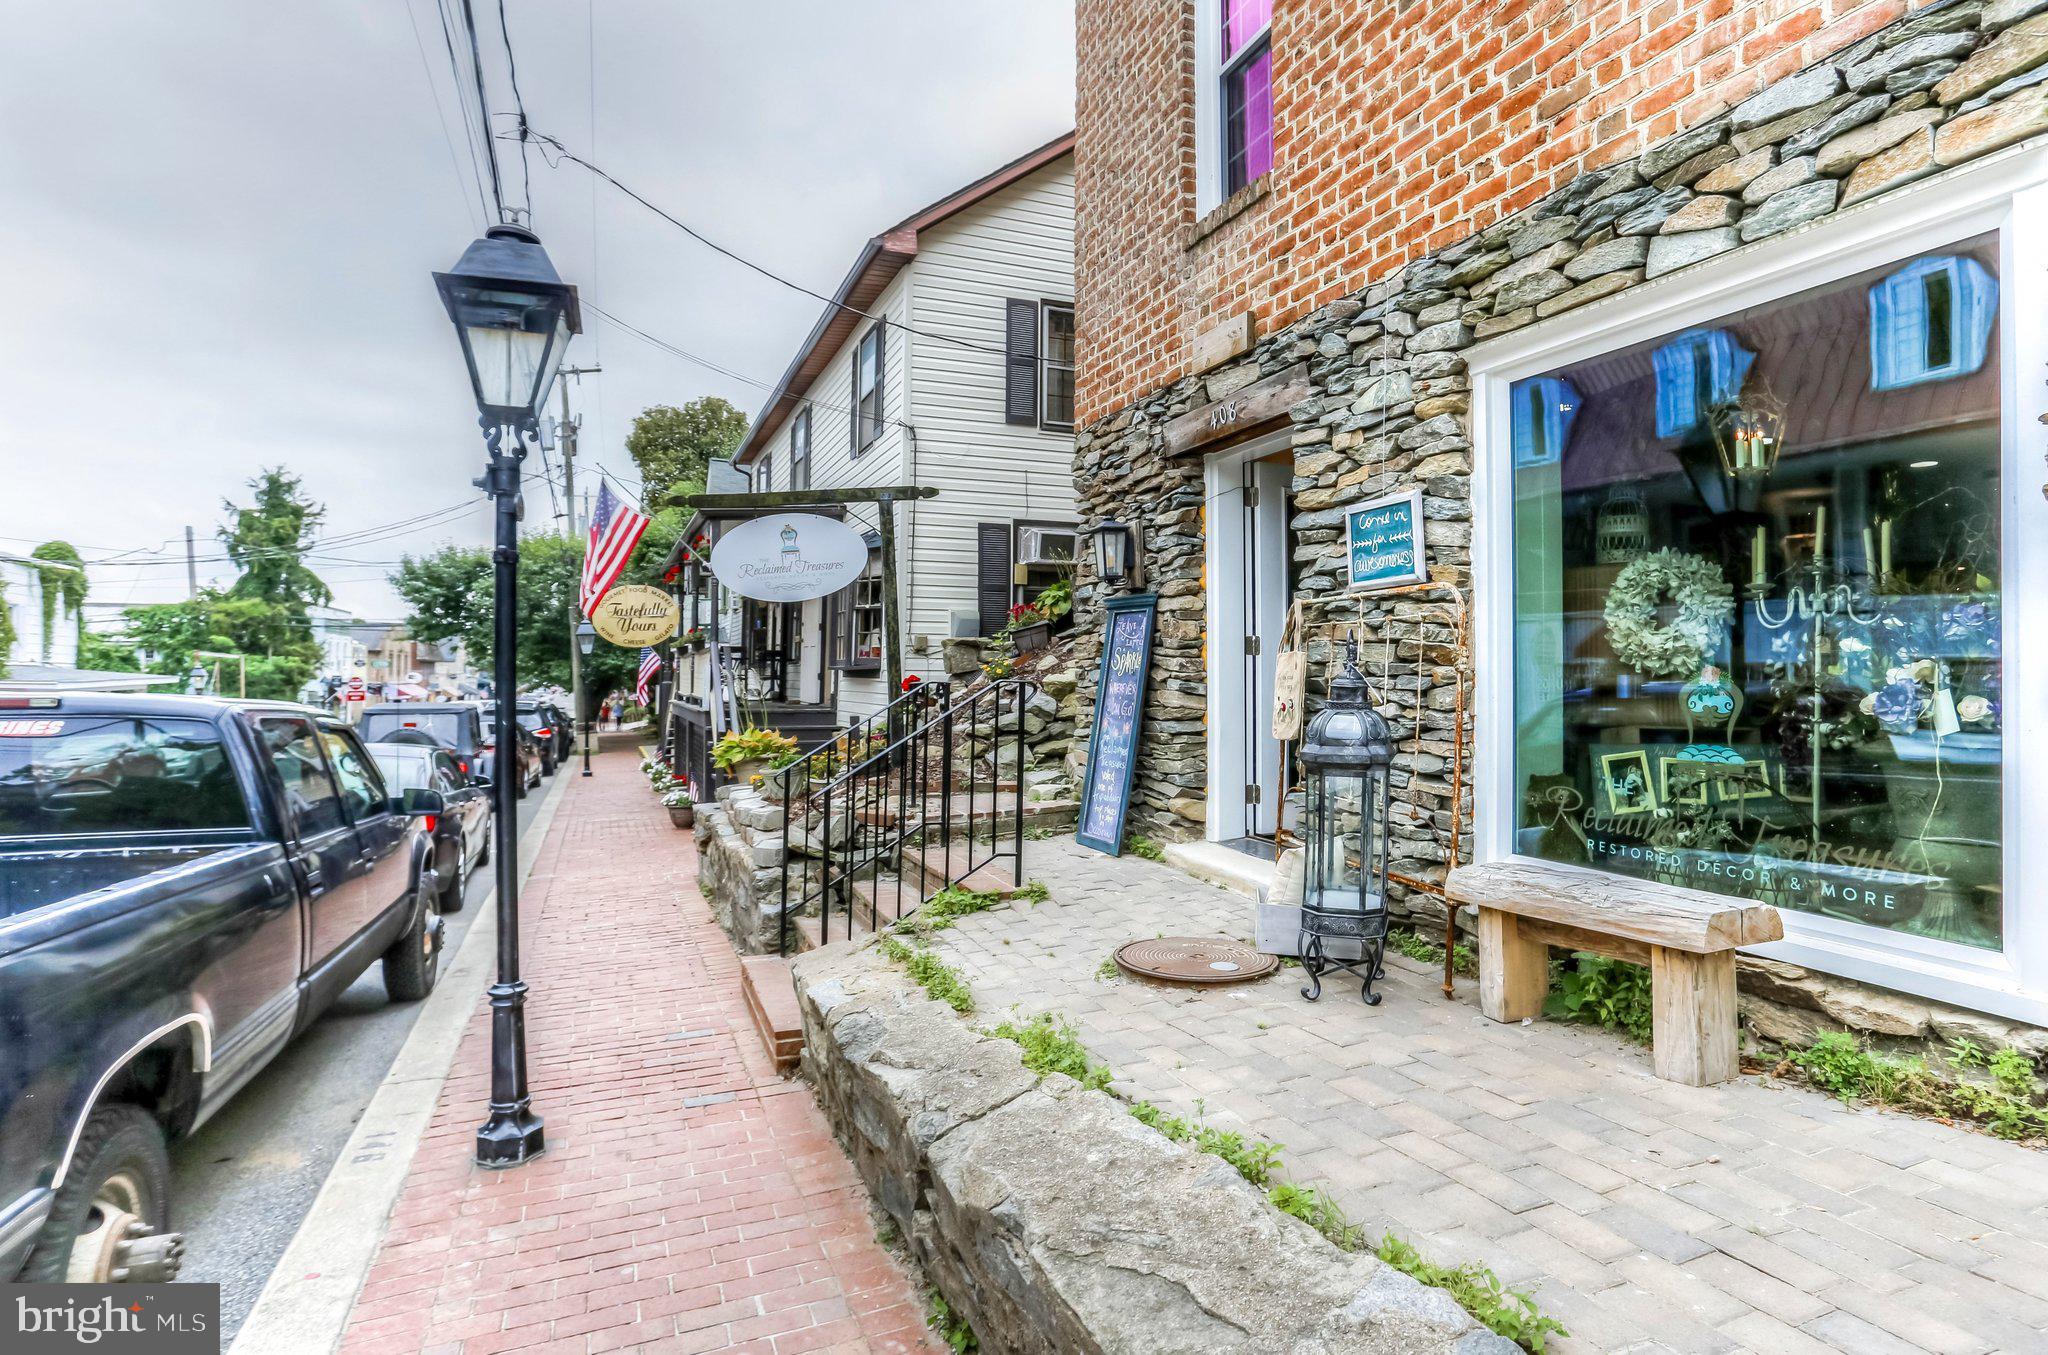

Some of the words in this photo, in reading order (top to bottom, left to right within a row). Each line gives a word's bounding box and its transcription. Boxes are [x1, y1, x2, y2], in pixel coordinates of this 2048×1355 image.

[1210, 402, 1238, 430] 408
[1358, 511, 1390, 529] Come
[1393, 507, 1408, 522] in
[1371, 533, 1387, 553] for
[738, 560, 793, 579] Reclaimed
[794, 559, 845, 574] Treasures
[650, 590, 674, 608] MARKET
[606, 602, 670, 619] Tastefully
[600, 625, 615, 639] WINE
[654, 623, 674, 641] GELATO
[616, 617, 657, 636] Yours
[1602, 775, 1635, 796] THE
[1538, 785, 1715, 862] Reclaimed
[1587, 839, 1682, 867] RESTORED
[1697, 859, 1771, 886] DÉCOR
[1789, 876, 1802, 891] &
[1820, 883, 1896, 910] MORE
